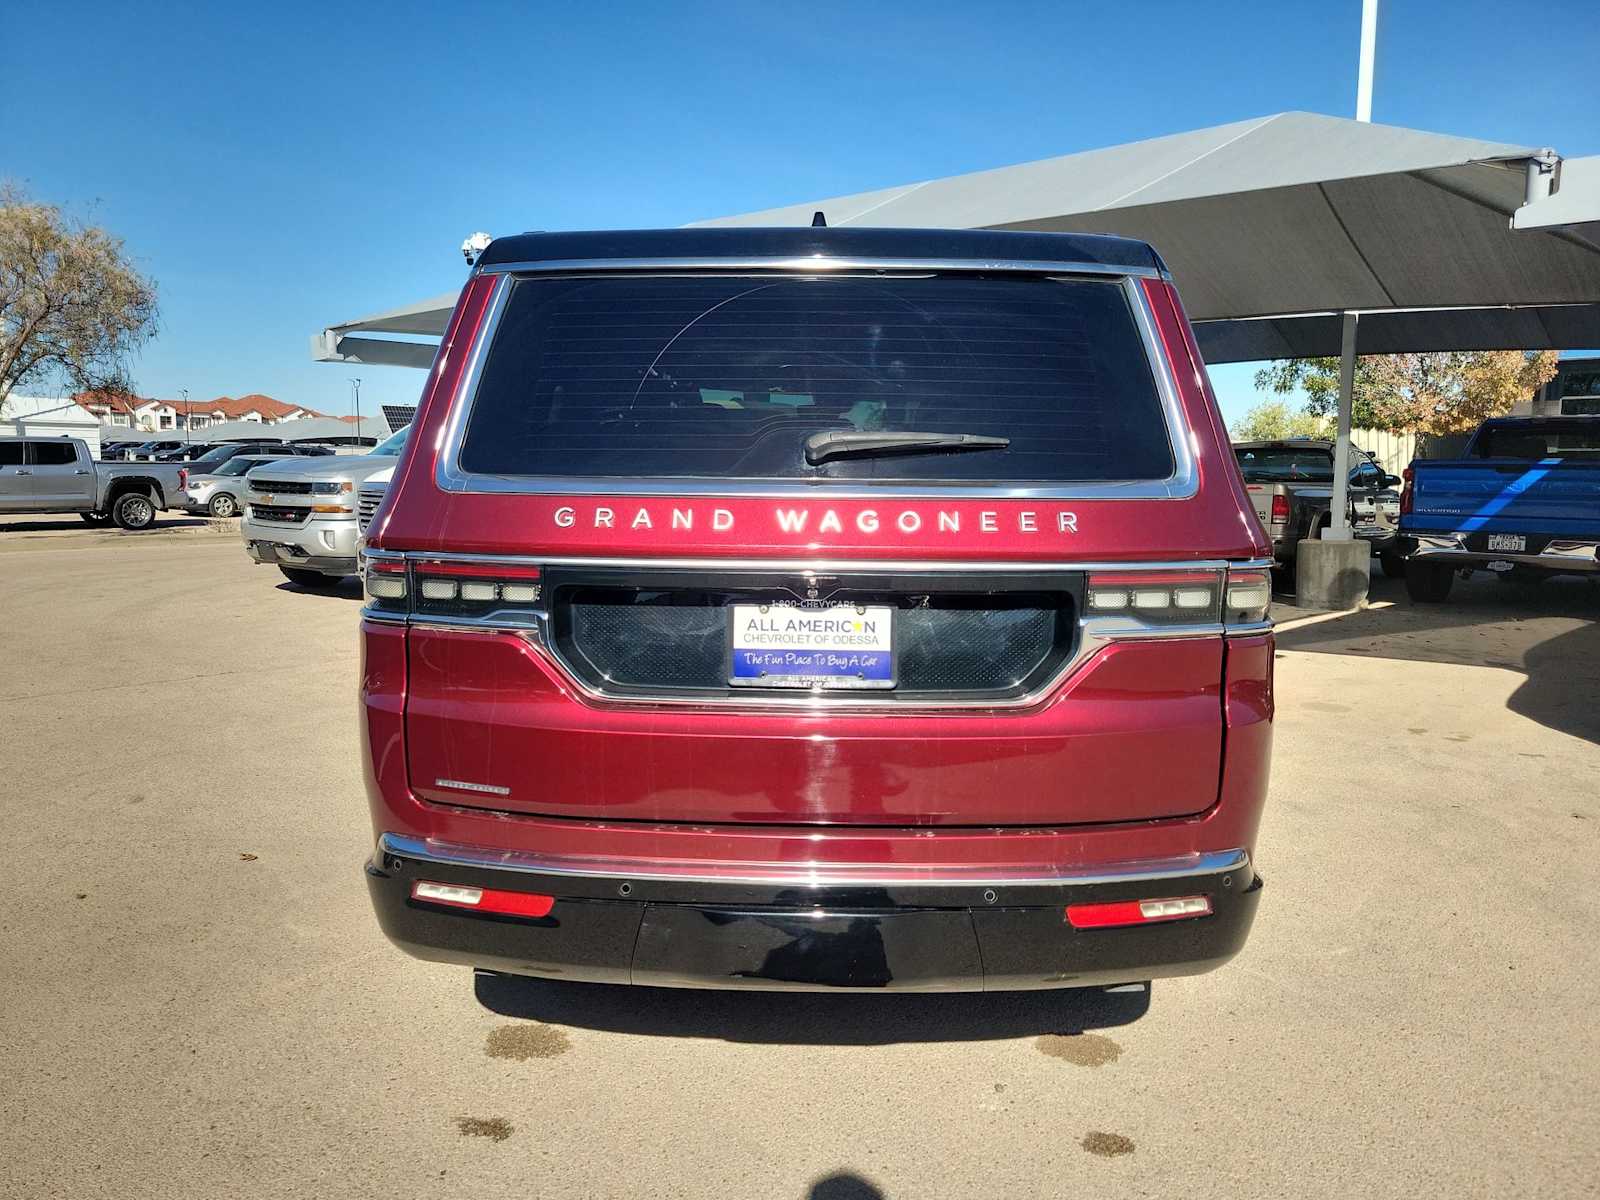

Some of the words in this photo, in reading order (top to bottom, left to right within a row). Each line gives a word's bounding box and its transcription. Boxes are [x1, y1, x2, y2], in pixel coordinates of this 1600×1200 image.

[554, 506, 735, 530] GRAND
[775, 508, 1078, 533] WAGONEER
[747, 618, 780, 632] ALL
[785, 618, 876, 634] AMERICN
[743, 633, 811, 645] CHEVROLET
[814, 634, 830, 645] OF
[832, 634, 880, 646] ODESSA
[743, 652, 763, 666] The
[764, 653, 784, 666] Fun
[785, 652, 812, 666] Place
[813, 653, 826, 666] To
[848, 655, 860, 667] A
